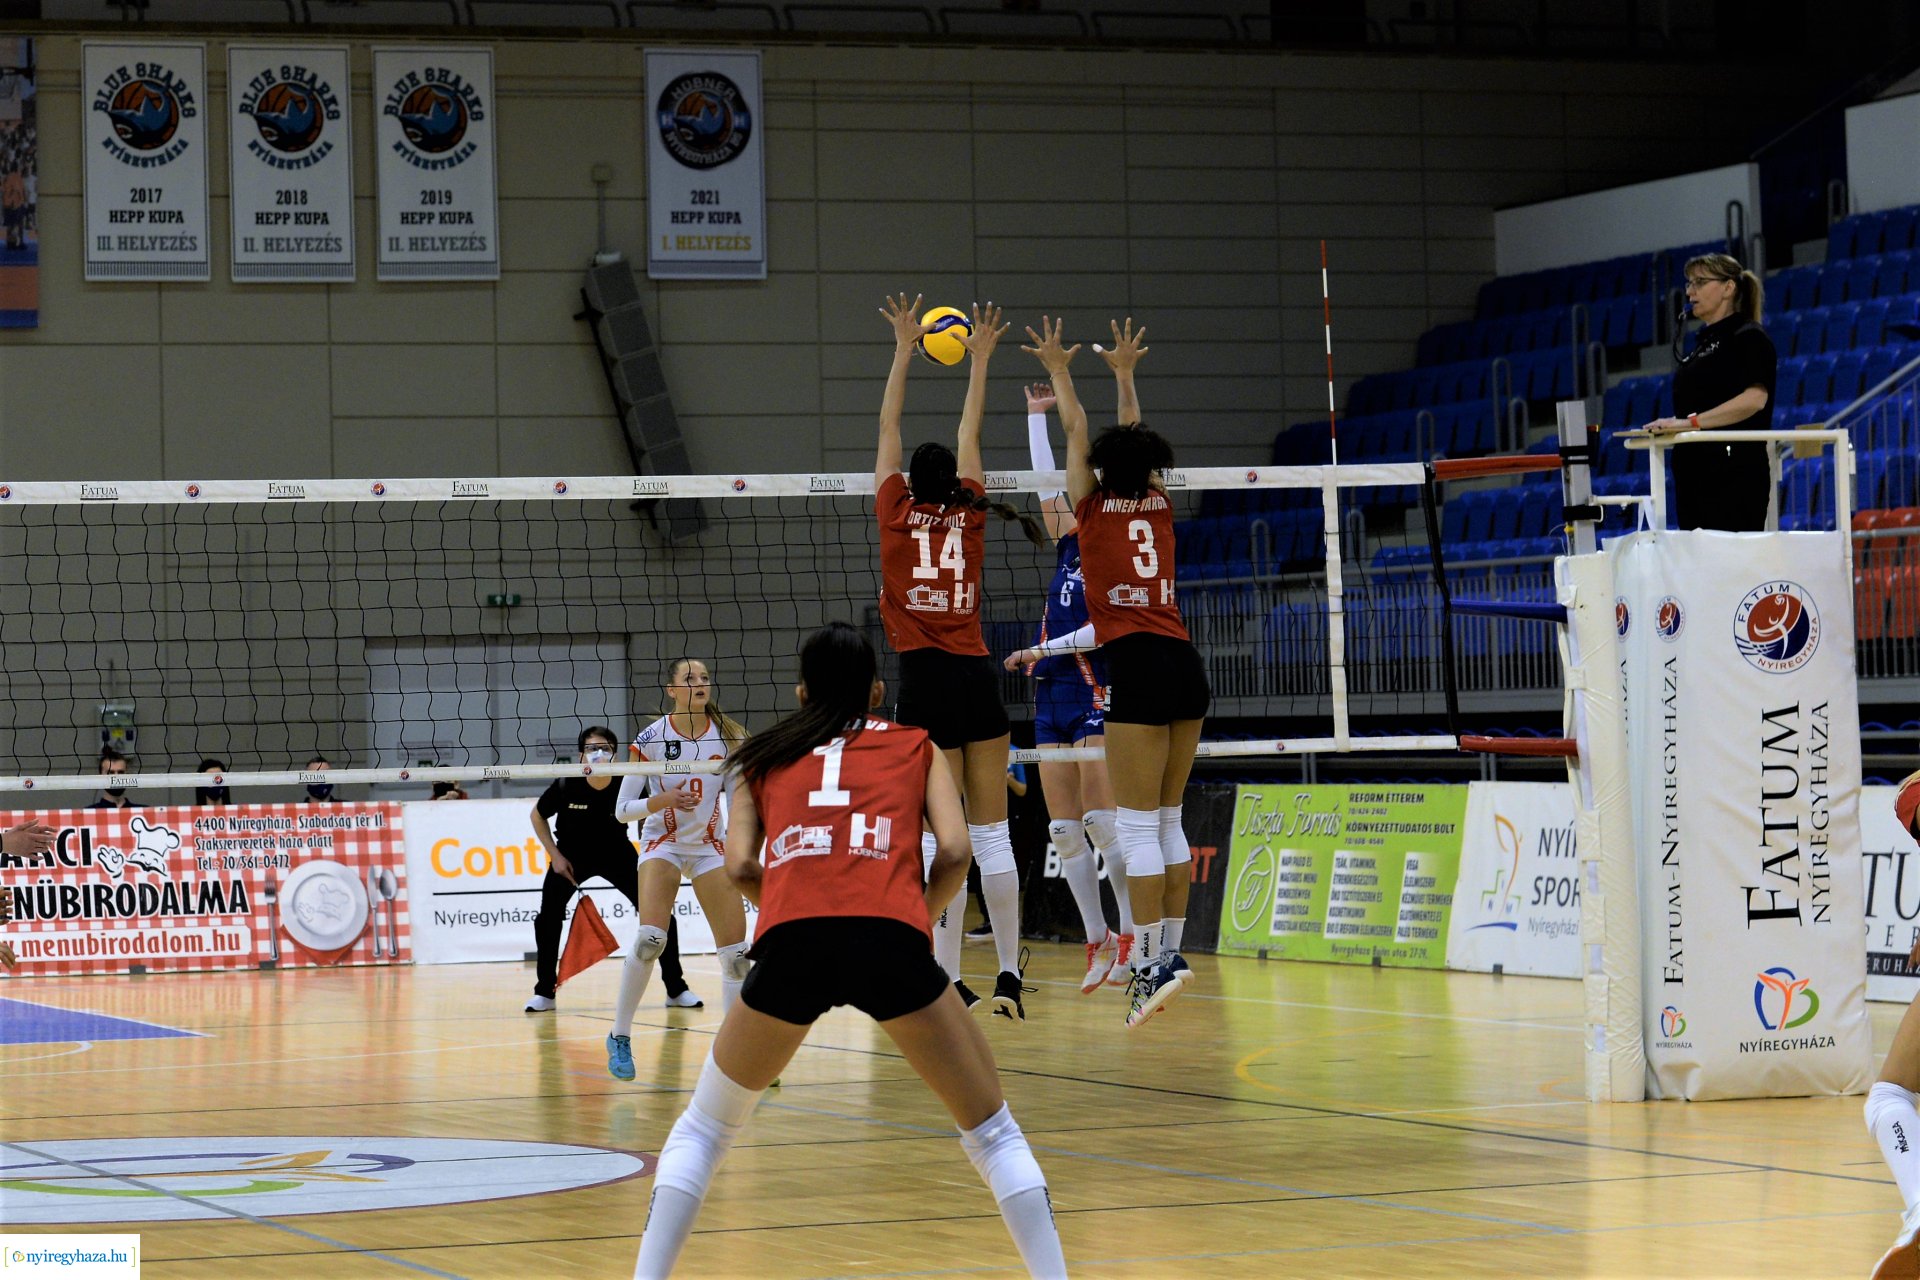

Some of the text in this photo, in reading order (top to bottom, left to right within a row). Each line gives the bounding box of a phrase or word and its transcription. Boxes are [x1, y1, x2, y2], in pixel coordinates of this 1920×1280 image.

[93, 66, 131, 114] BLUE
[239, 69, 277, 117] BLUE
[384, 71, 420, 118] BLUE
[130, 188, 162, 204] 2017
[276, 190, 308, 205] 2018
[421, 190, 452, 205] 2019
[691, 190, 720, 205] 2021
[109, 210, 184, 223] HEPP KUPA
[256, 212, 329, 225] HEPP KUPA
[401, 212, 474, 225] HEPP KUPA
[671, 211, 742, 224] HEPP KUPA
[97, 231, 197, 251] III. HELYEZÉS
[243, 232, 342, 252] II. HELYEZÉS
[388, 231, 487, 252] II. HELYEZÉS
[662, 231, 752, 250] I. HELYEZÉS
[908, 511, 940, 526] ORTIZ
[911, 524, 966, 580] 14
[1128, 519, 1158, 578] 3
[1060, 581, 1075, 607] 6
[1738, 583, 1790, 623] FATUM
[1757, 617, 1818, 670] NYÍREGYHÁZA
[808, 736, 850, 807] 1
[1349, 791, 1424, 803] REFORM ÉTTEREM
[1741, 700, 1802, 929] FATUM
[1808, 700, 1831, 924] NYÍREGYHÁZA
[195, 817, 225, 831] 4400
[229, 816, 295, 831] Nyíregyháza,
[299, 815, 351, 829] Szabadság
[355, 815, 370, 827] tér
[1345, 821, 1455, 833] KÖRNYEZETTUDATOS BOLT
[195, 835, 333, 851] Szakszervezetek háza alatt
[197, 856, 219, 870] Tel.:
[1739, 1034, 1836, 1053] NYÍREGYHÁZA
